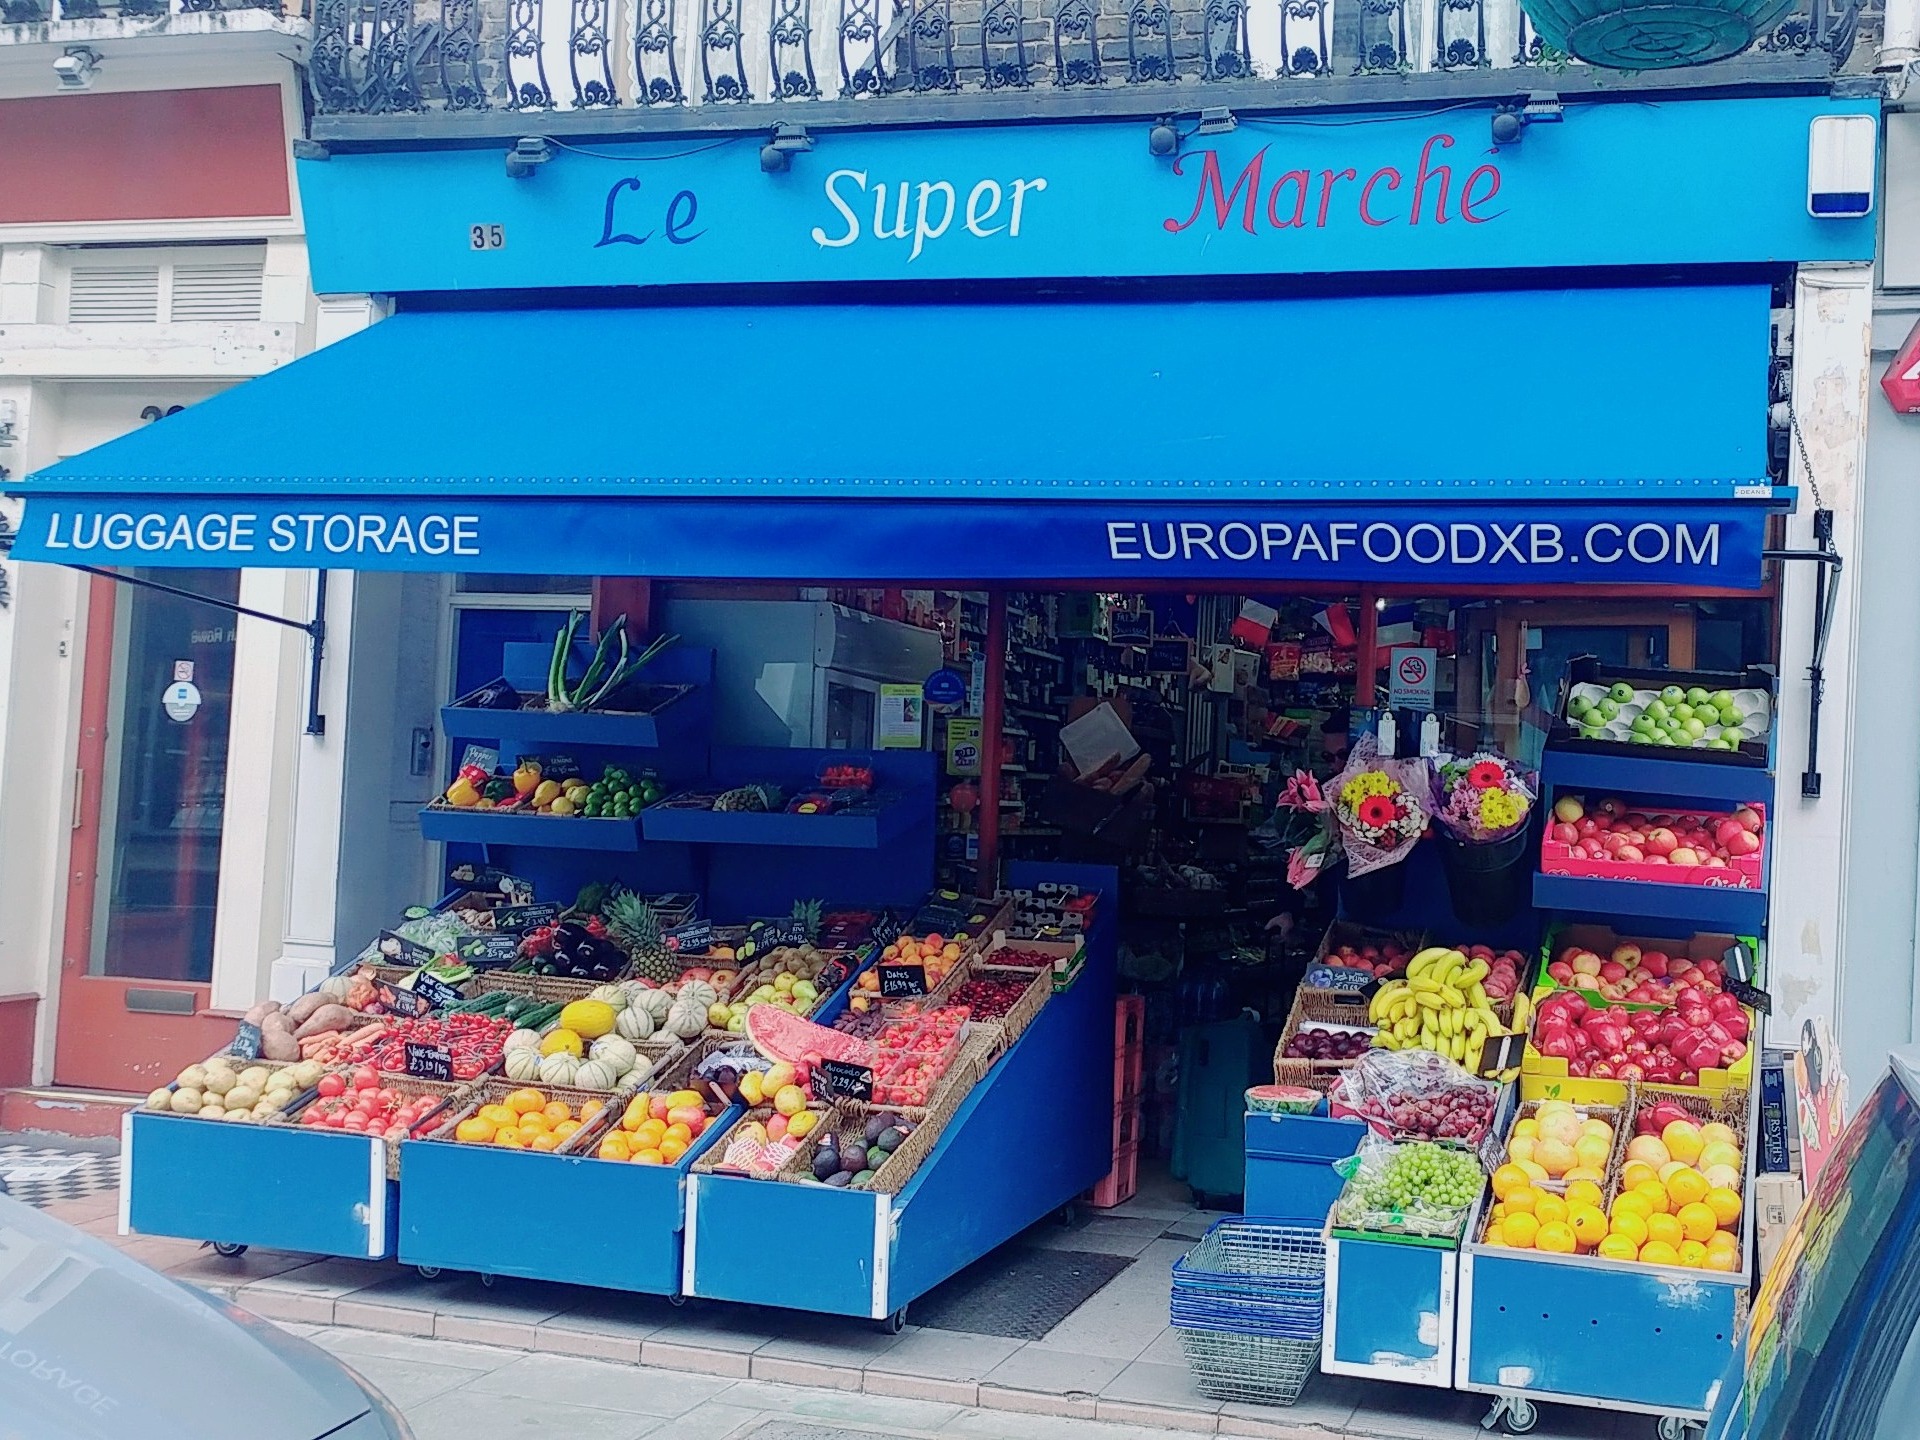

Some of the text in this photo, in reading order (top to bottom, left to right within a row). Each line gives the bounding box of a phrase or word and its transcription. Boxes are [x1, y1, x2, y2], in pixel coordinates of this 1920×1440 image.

[593, 133, 1511, 264] Le Super Marché
[472, 225, 503, 249] 35
[45, 512, 481, 556] LUGGAGE STORAGE
[1106, 521, 1721, 567] EUROPAFOODXB.COM
